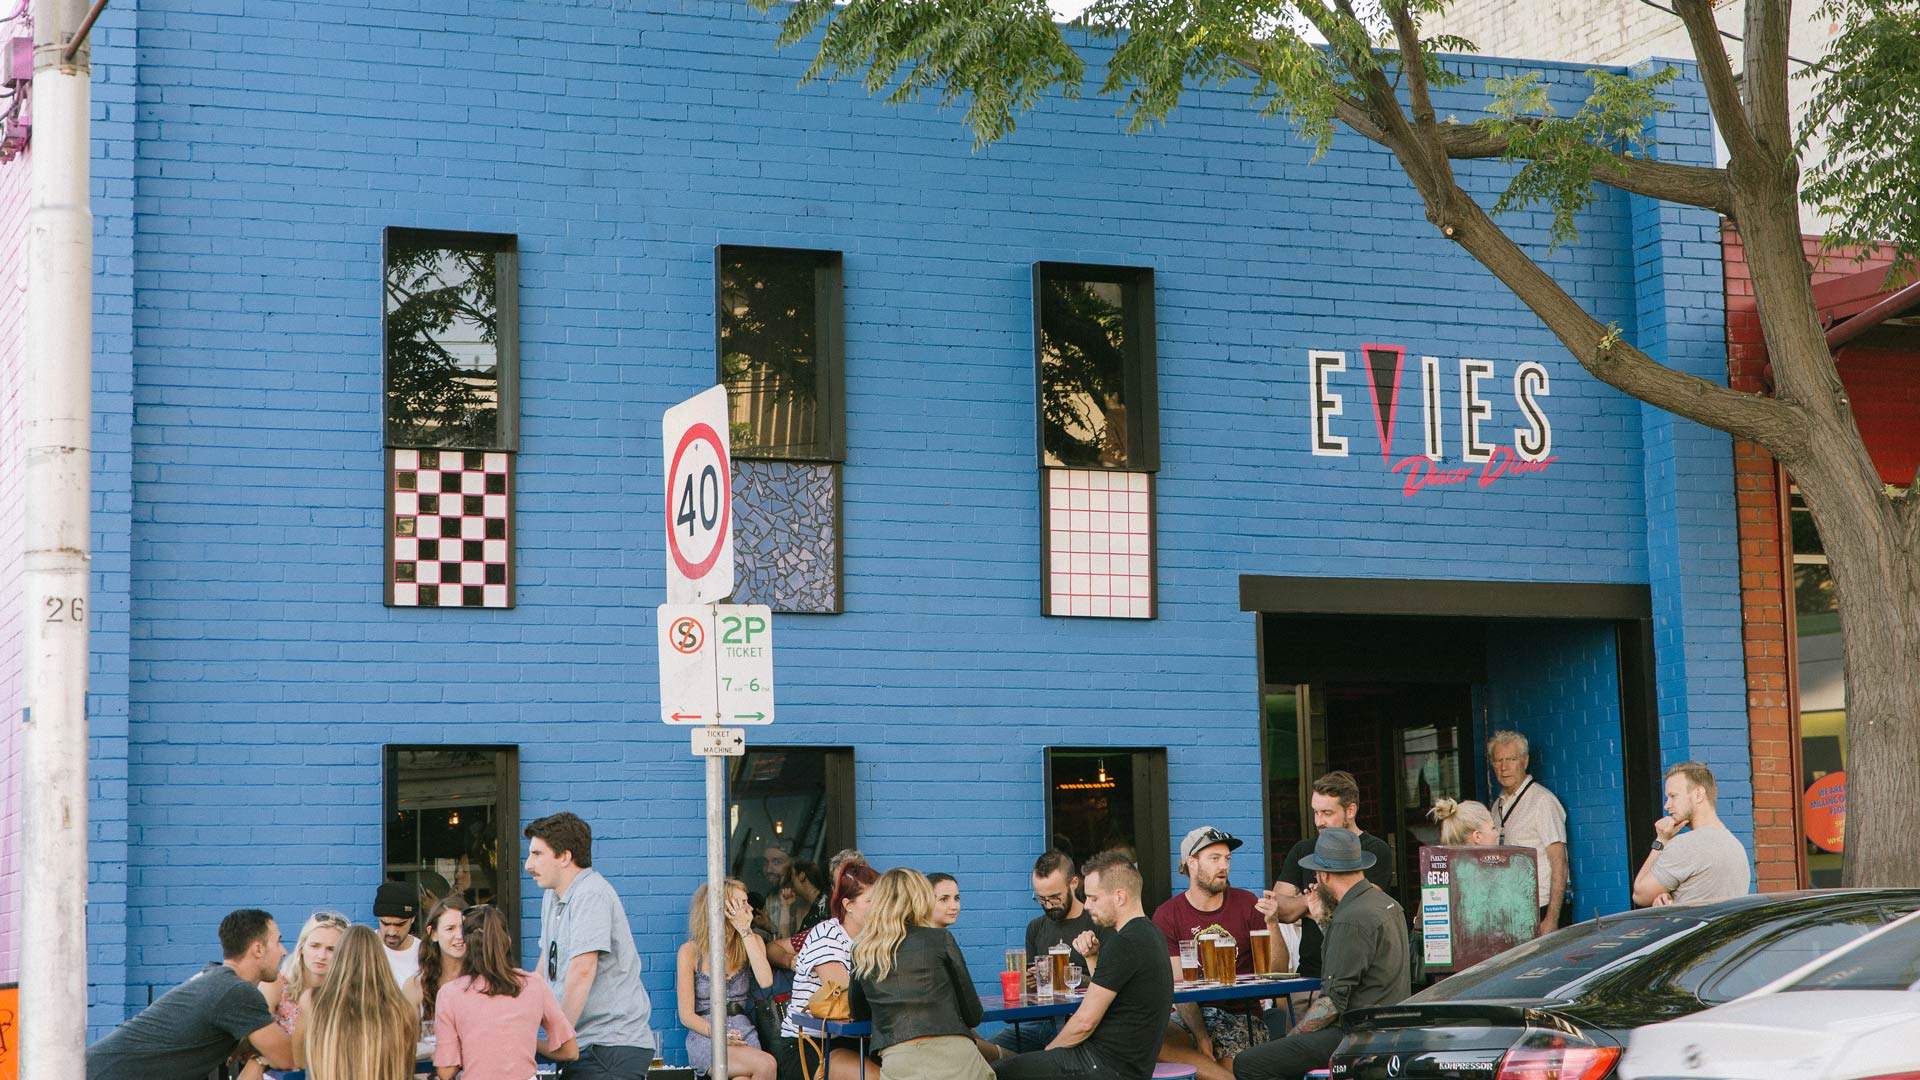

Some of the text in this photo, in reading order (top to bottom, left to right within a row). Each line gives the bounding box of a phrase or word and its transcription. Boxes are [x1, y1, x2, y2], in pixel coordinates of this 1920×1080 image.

[1308, 343, 1552, 464] EVIES
[676, 464, 719, 537] 40
[46, 596, 84, 622] 26
[721, 616, 766, 644] 2P
[726, 647, 763, 658] TICKET
[1439, 1062, 1493, 1071] KOMPRESSOR
